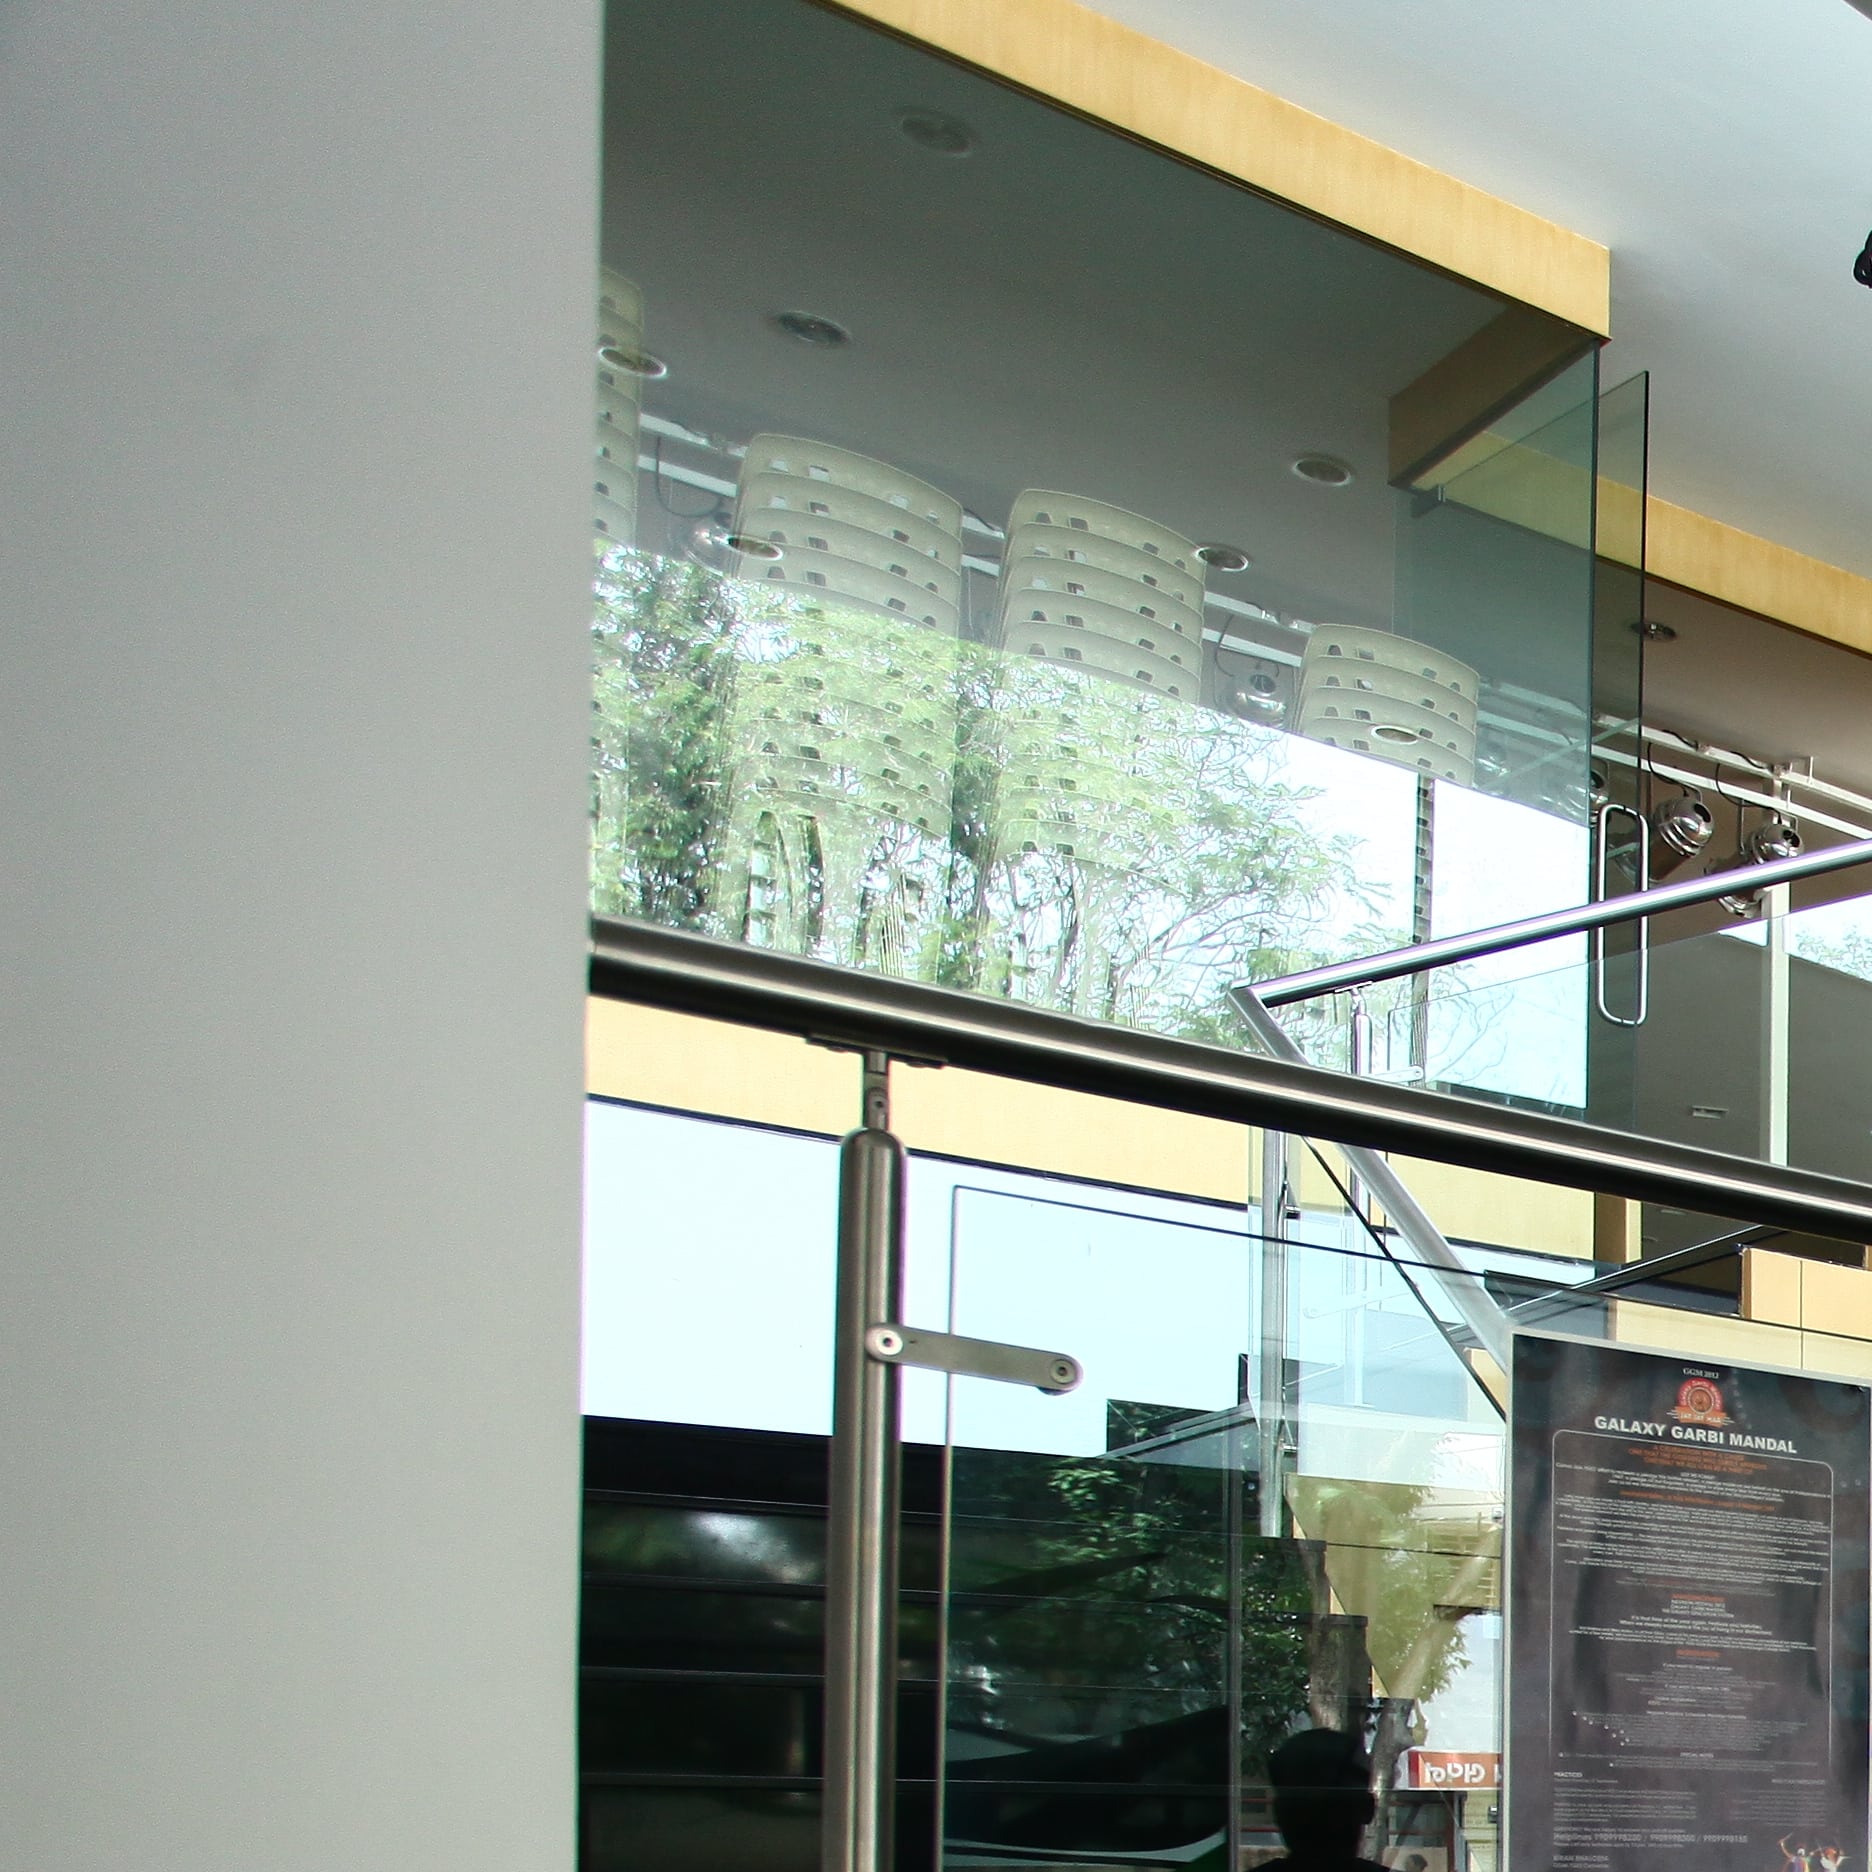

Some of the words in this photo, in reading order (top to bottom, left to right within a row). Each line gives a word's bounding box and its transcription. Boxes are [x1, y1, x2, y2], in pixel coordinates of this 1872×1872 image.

[1594, 1416, 1667, 1437] GALAXY
[1671, 1426, 1725, 1445] GARBI
[1729, 1433, 1798, 1454] MANDAL
